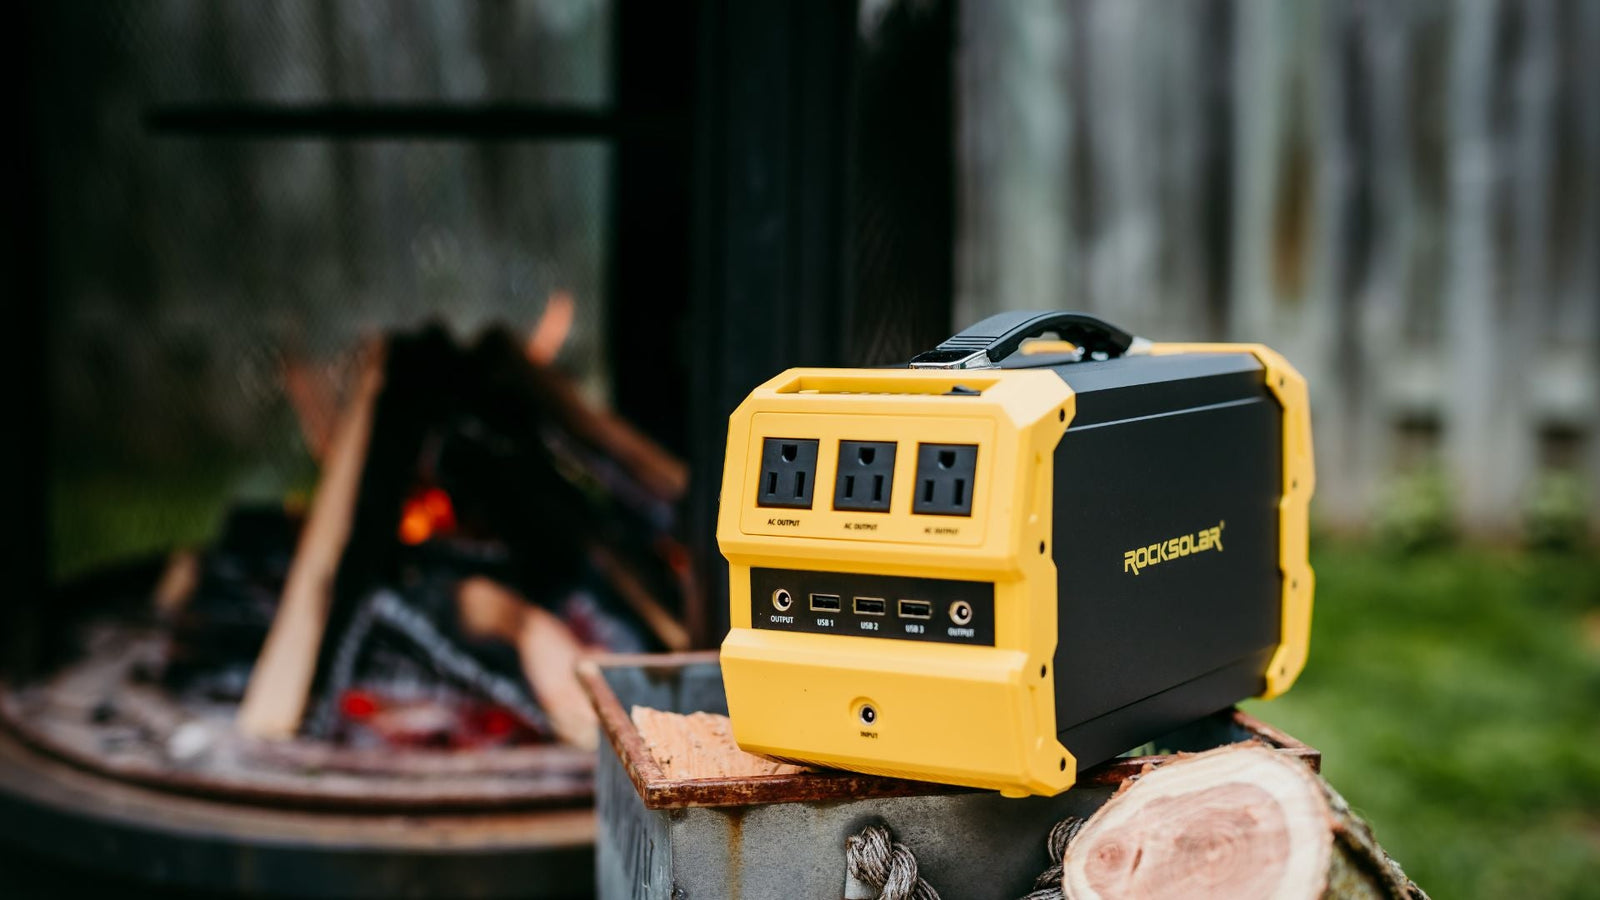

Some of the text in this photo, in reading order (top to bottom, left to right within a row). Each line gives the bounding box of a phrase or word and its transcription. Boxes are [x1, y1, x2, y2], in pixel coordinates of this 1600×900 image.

[777, 519, 800, 527] OUTPUT
[770, 615, 794, 624] OUTPUT
[817, 618, 834, 627] USB 1
[860, 621, 879, 631] USB 2
[905, 624, 918, 634] USB
